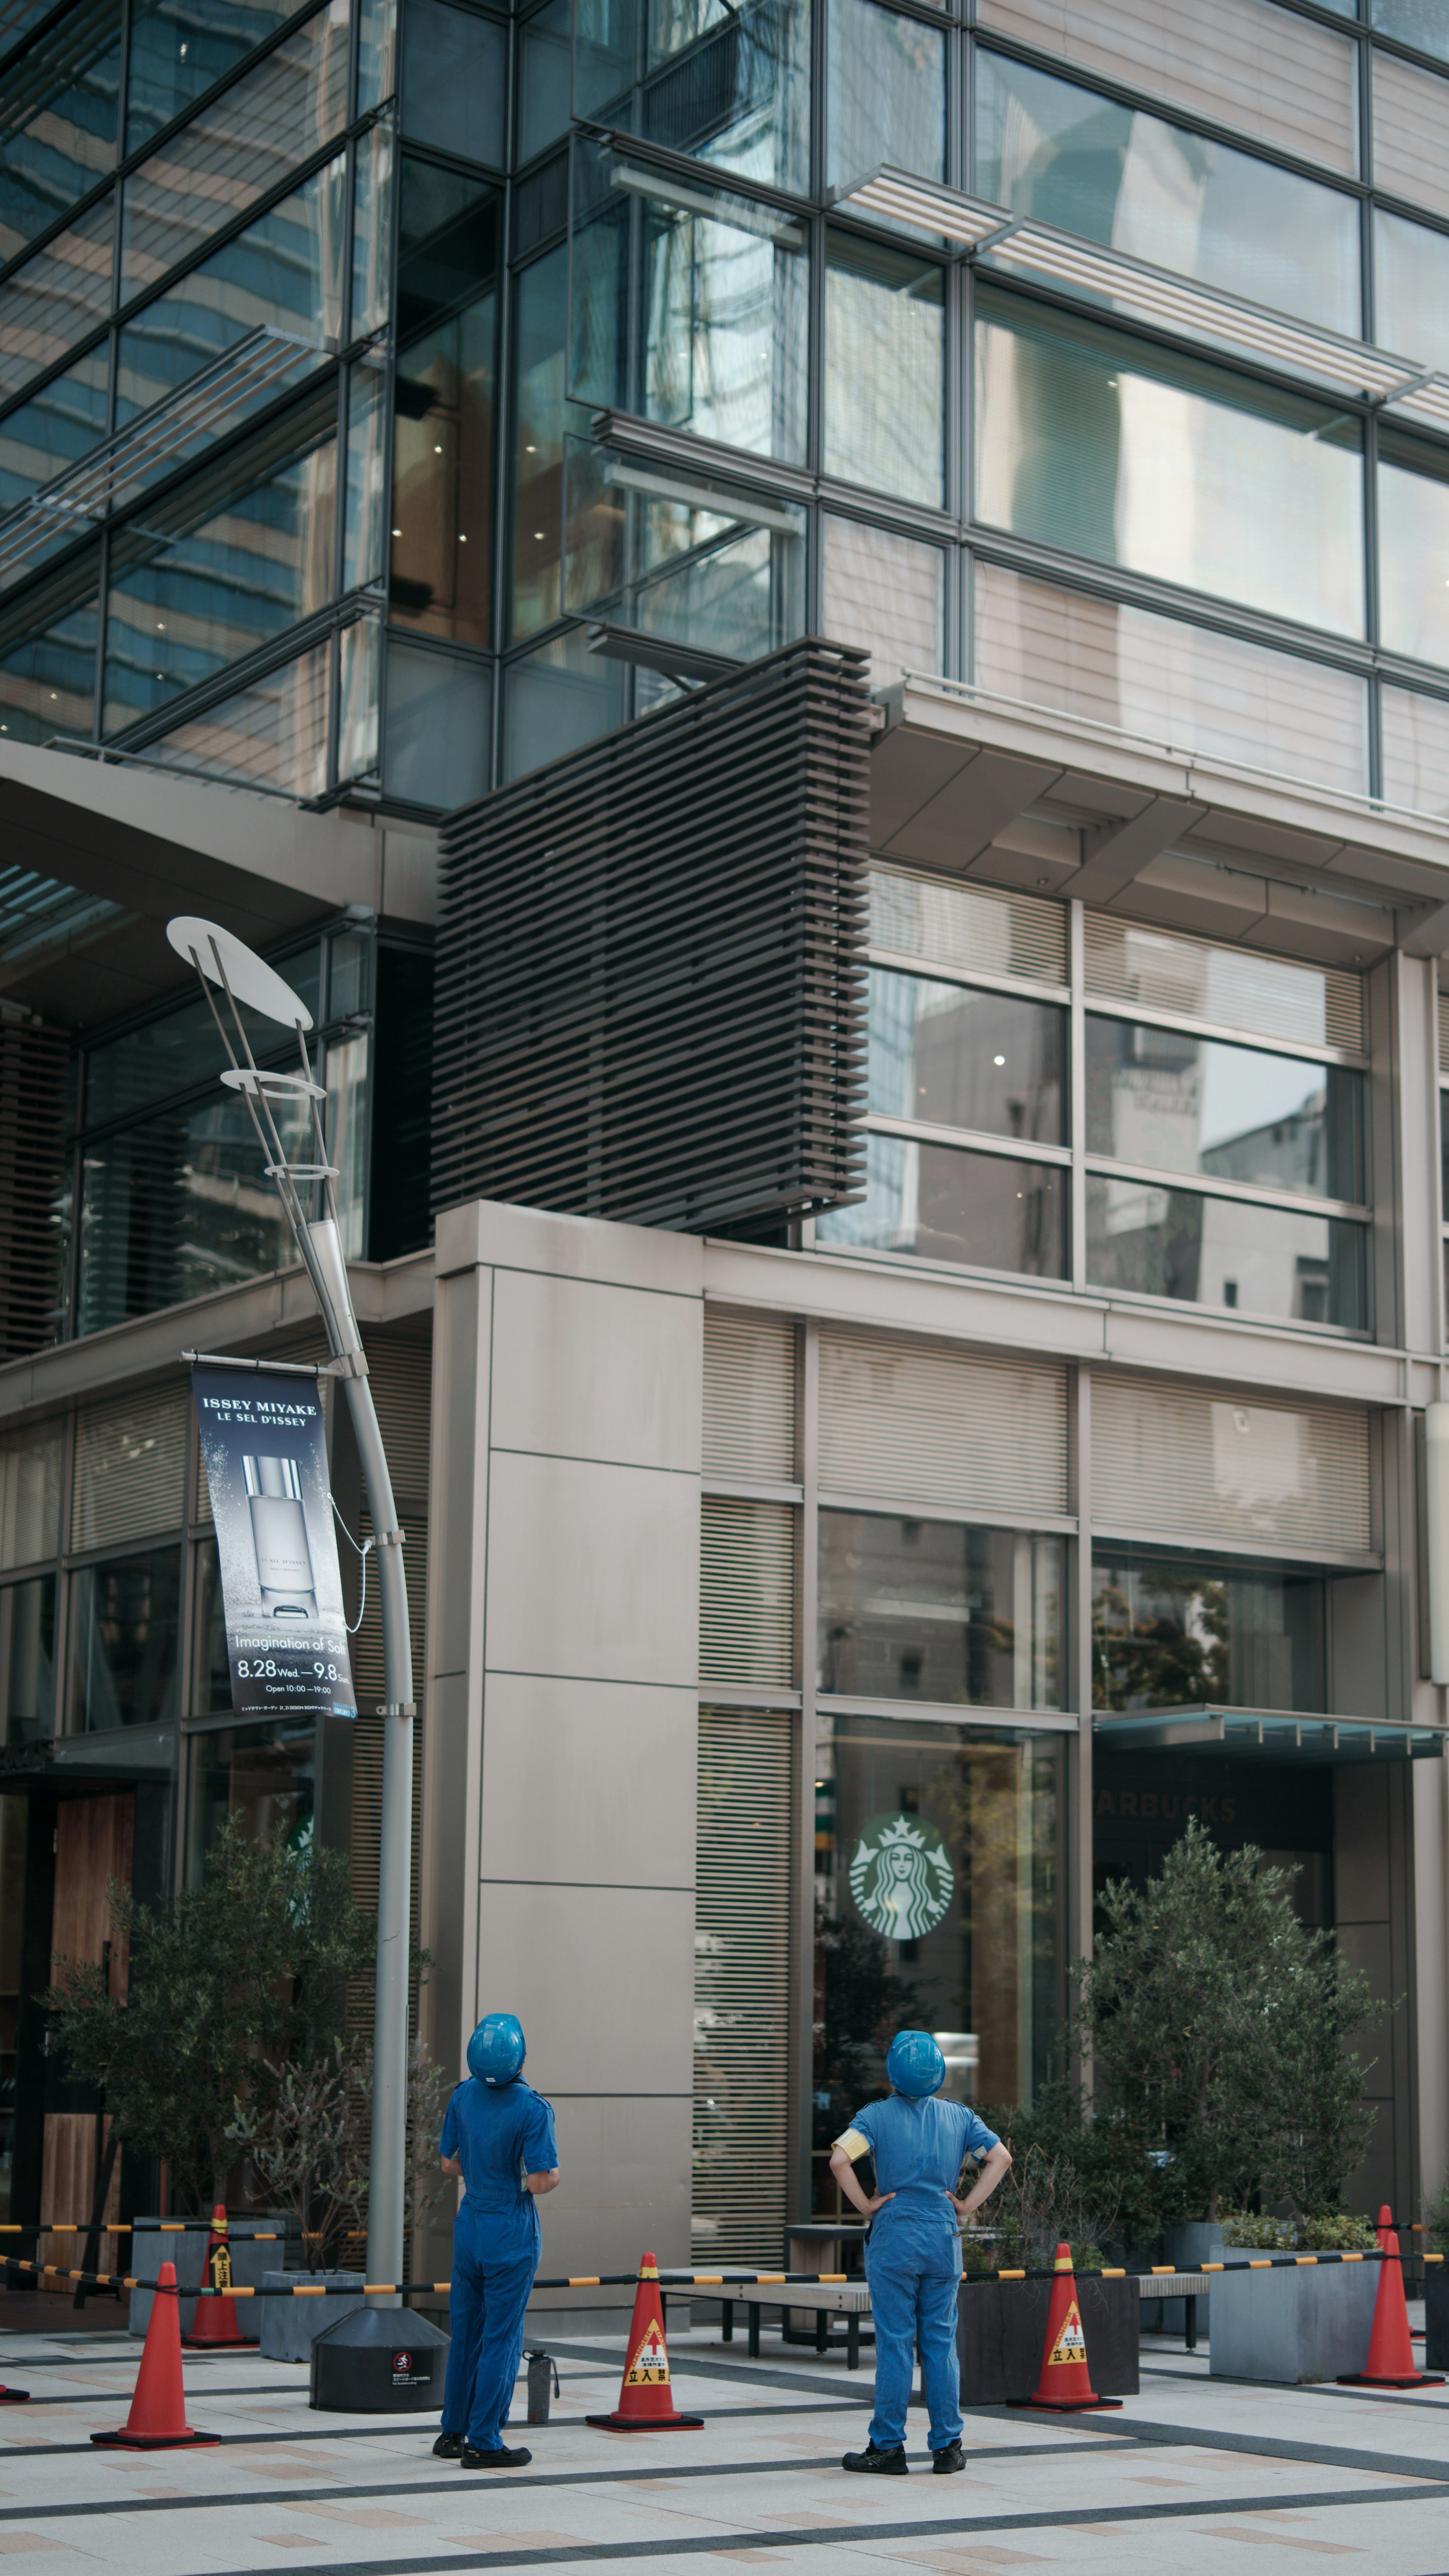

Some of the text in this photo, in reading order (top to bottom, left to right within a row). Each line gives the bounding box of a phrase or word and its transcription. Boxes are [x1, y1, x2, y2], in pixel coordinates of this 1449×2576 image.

[203, 1397, 317, 1416] ISSEY MIYAKE
[217, 1412, 306, 1426] LE SEL D'ISSEY
[235, 1635, 346, 1655] Imagination of Salt
[238, 1660, 276, 1678] 8.28
[277, 1668, 300, 1678] Wed.
[313, 1662, 337, 1681] 9.8
[338, 1674, 351, 1685] Sun.
[265, 1685, 285, 1694] Open
[350, 1705, 356, 1719] 3
[1094, 1790, 1237, 1822] ARBUCKS
[1055, 2312, 1072, 2347] DANGER
[631, 2330, 652, 2367] DANGER
[1053, 2348, 1085, 2361] 立入禁
[629, 2368, 671, 2382] 立入禁
